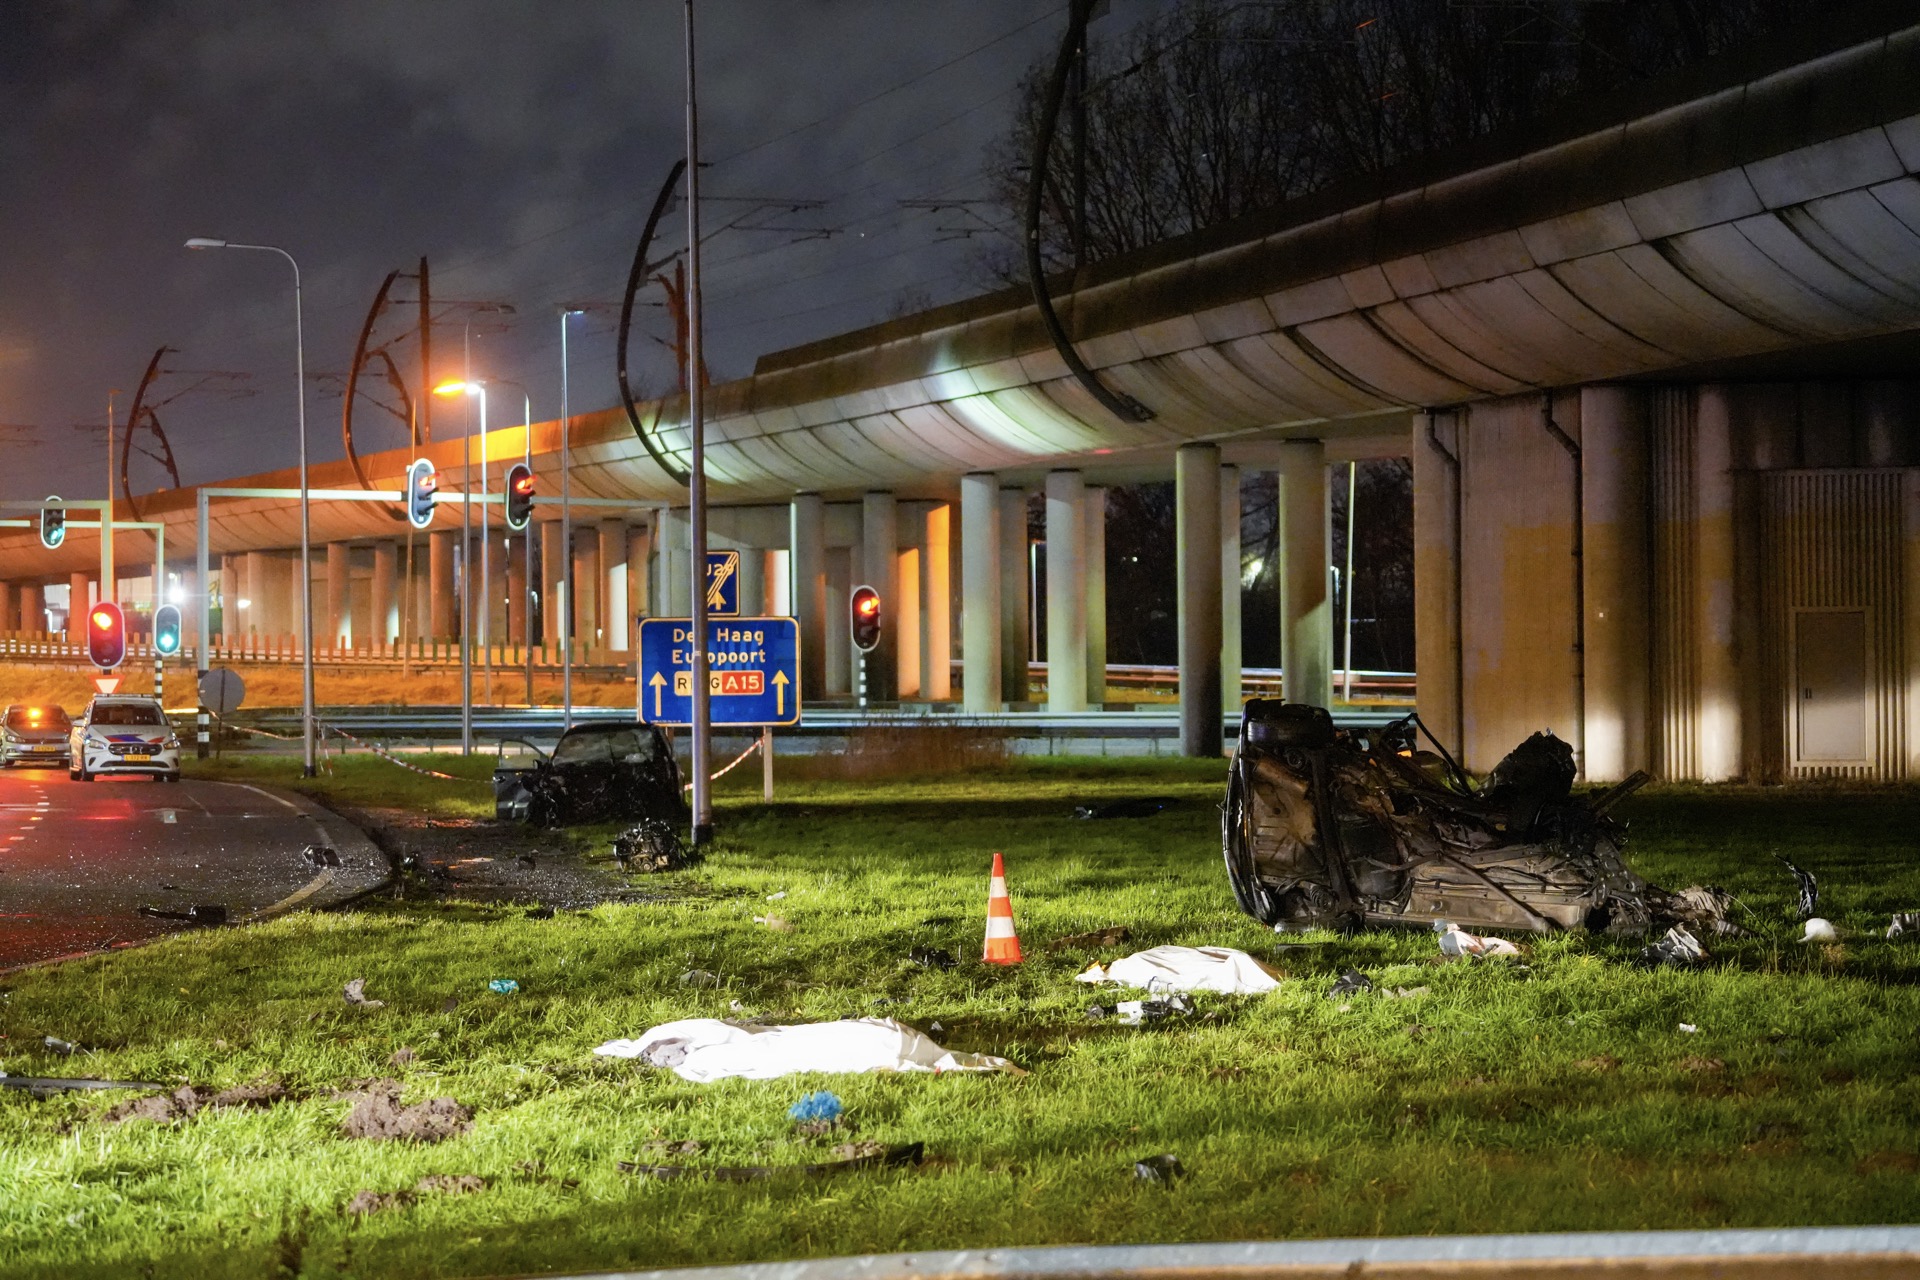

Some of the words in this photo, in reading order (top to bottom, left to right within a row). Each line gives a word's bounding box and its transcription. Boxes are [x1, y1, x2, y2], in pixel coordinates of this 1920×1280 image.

[673, 628, 699, 643] De
[717, 628, 764, 646] Haag
[672, 649, 766, 666] Euopoort
[677, 677, 720, 689] RG
[725, 675, 760, 690] A15
